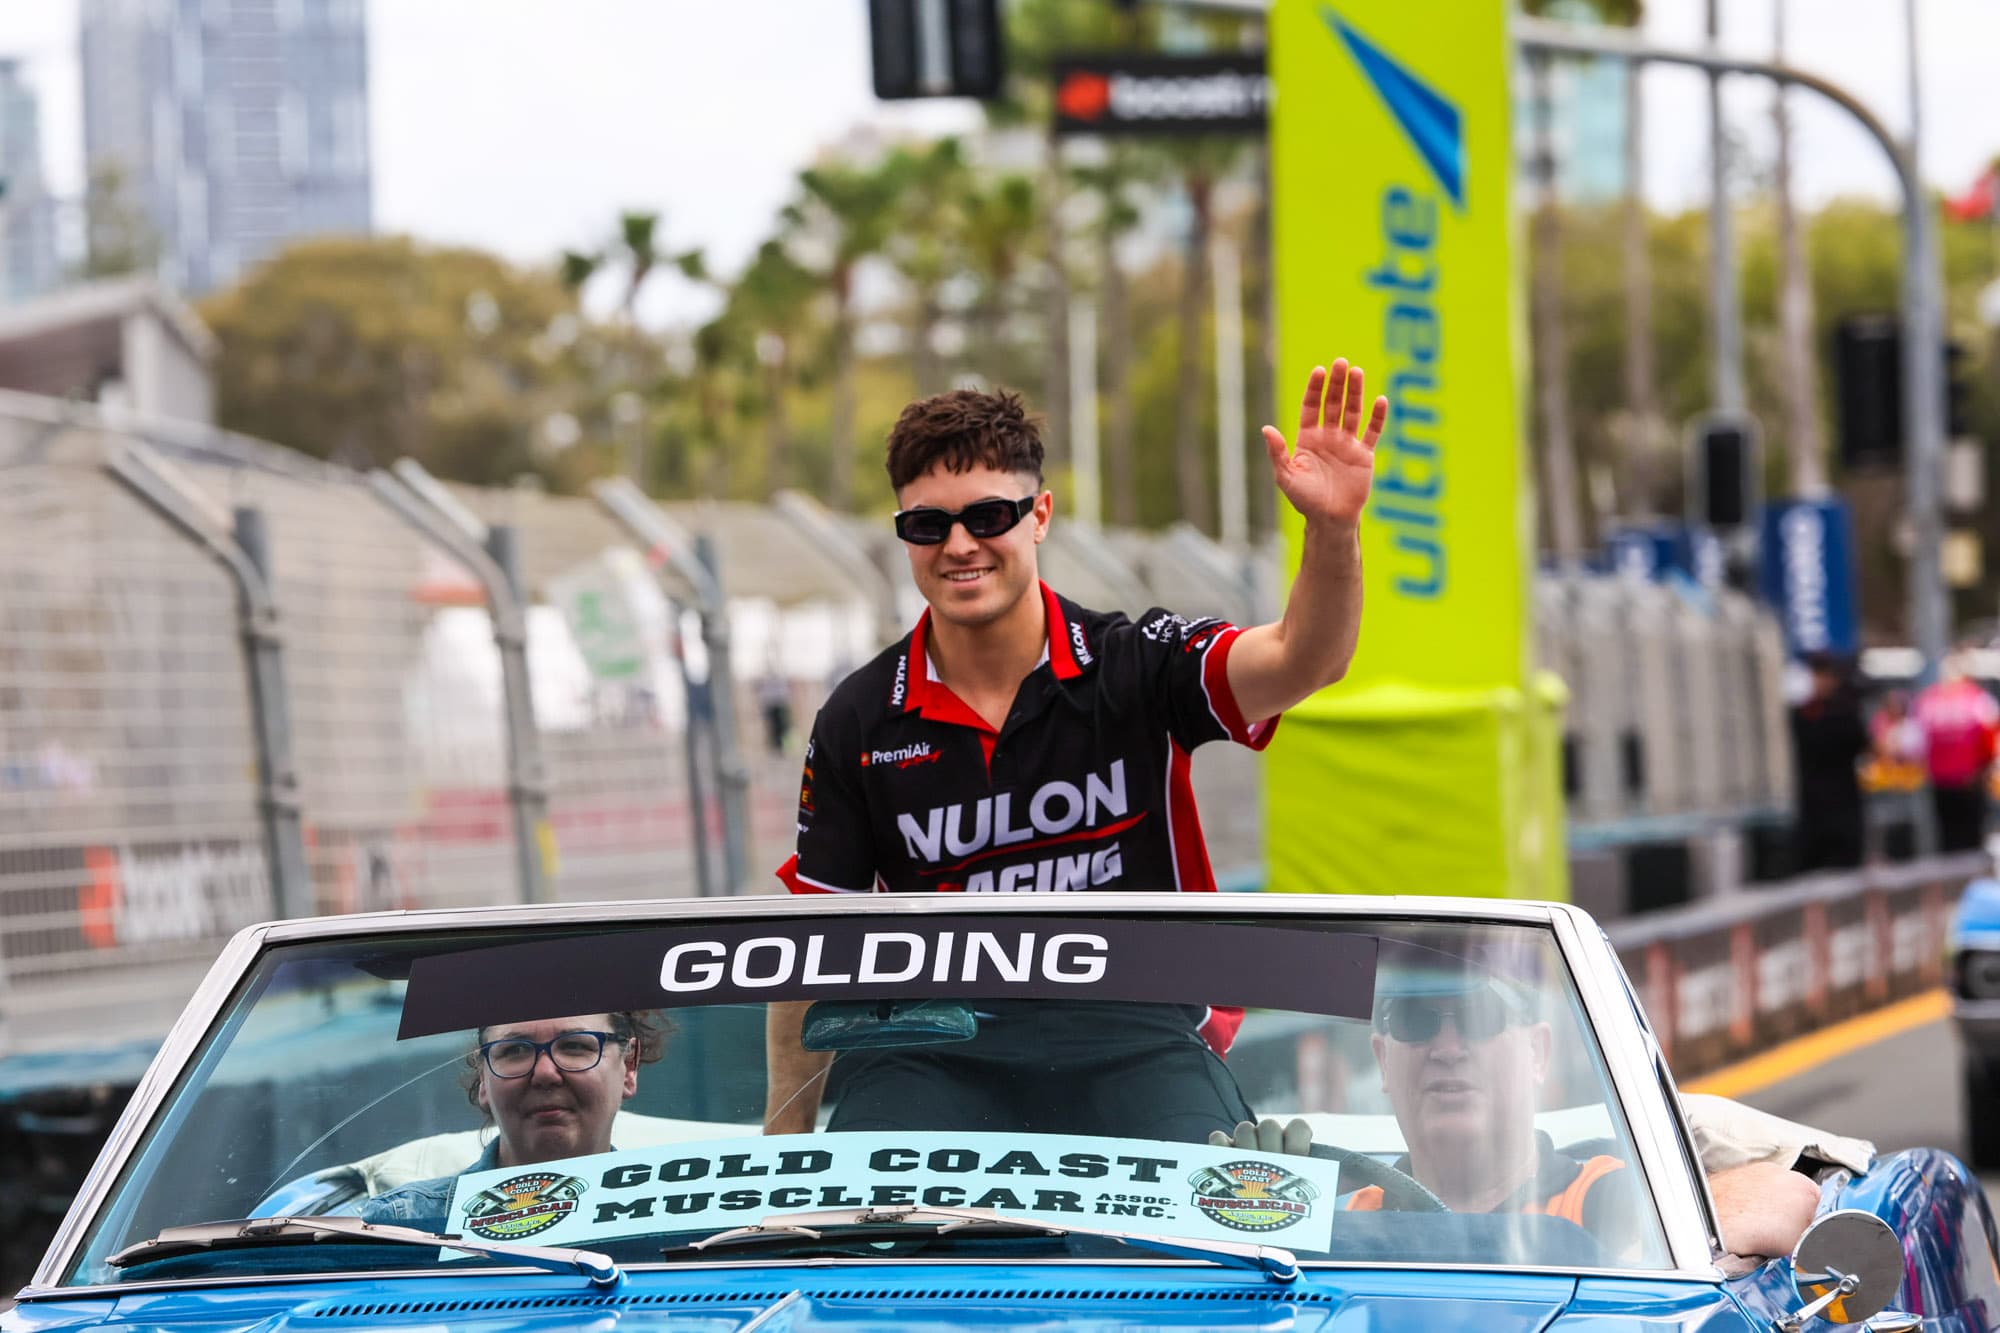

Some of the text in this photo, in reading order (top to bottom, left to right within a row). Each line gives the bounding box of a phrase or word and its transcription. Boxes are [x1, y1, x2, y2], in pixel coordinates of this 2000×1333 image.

[1366, 187, 1446, 597] ultimate
[892, 655, 907, 706] NULON
[871, 742, 930, 765] PremiAir
[897, 758, 1128, 863] NULON
[936, 842, 1123, 892] ACING
[659, 931, 1109, 992] GOLDING
[600, 1148, 1179, 1190] GOLD COAST
[1238, 1174, 1272, 1183] COAST
[1242, 1169, 1268, 1177] GOLD
[510, 1185, 543, 1195] COAST
[515, 1180, 540, 1189] GOLD
[592, 1185, 1085, 1224] MUSCLECAR
[1094, 1202, 1177, 1220] INC.
[1095, 1192, 1179, 1207] ASSOC.
[1198, 1196, 1307, 1214] MUSCLECAR
[470, 1201, 574, 1228] MUSCLECAR
